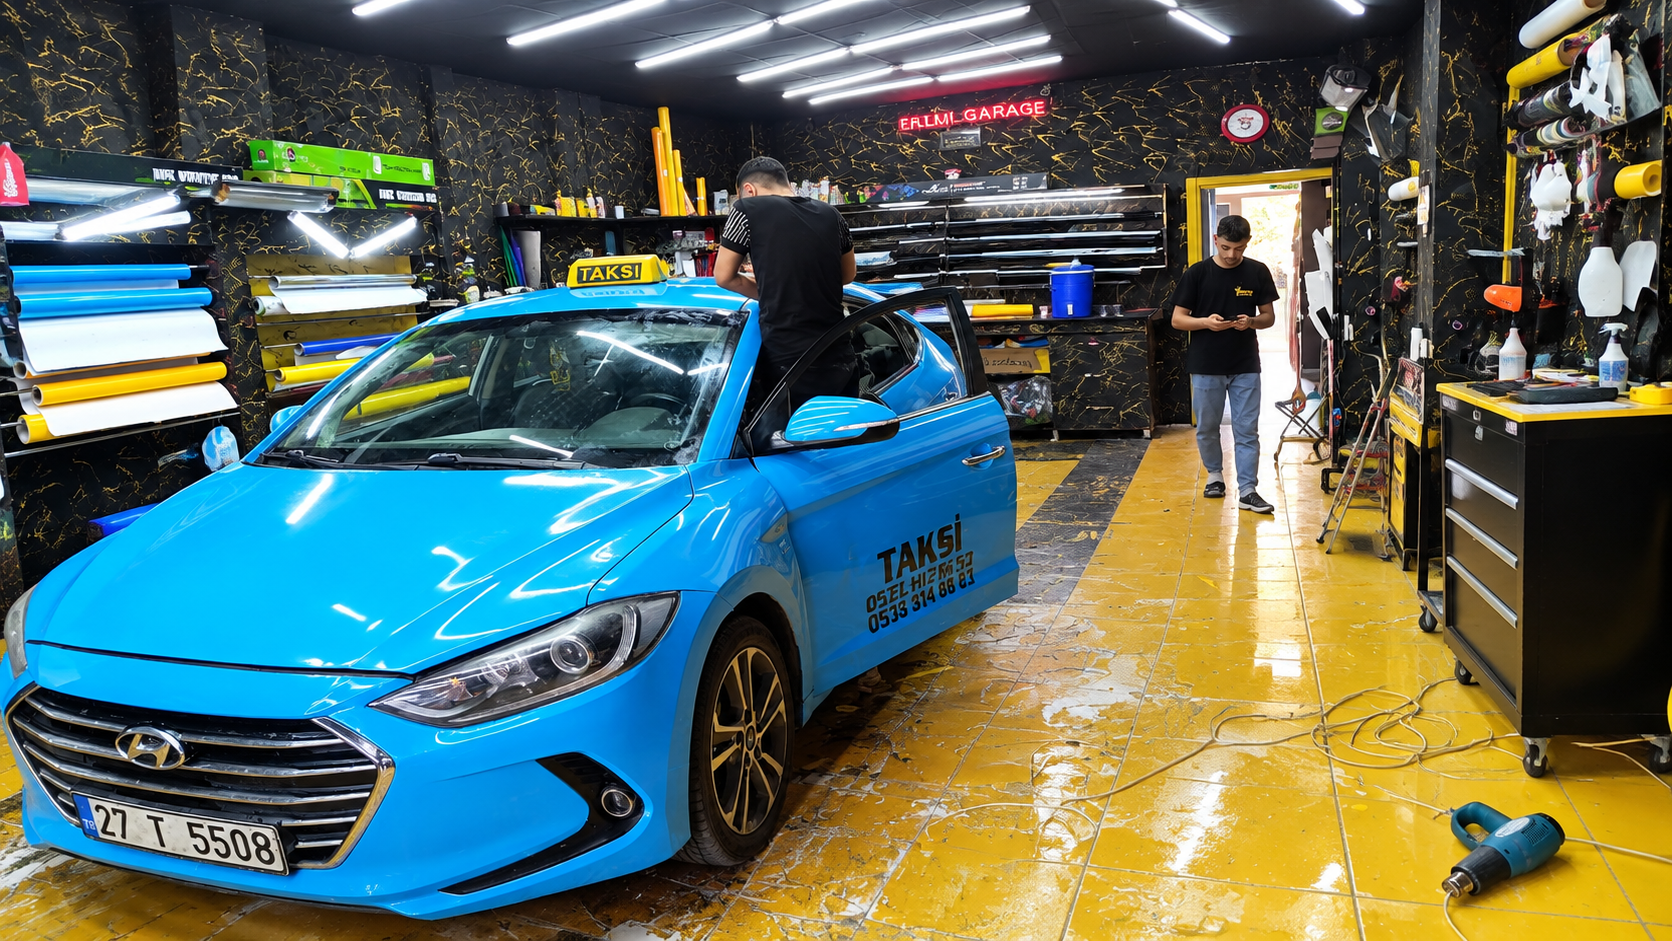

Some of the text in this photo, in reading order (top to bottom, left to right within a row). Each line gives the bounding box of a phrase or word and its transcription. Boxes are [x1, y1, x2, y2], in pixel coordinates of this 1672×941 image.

[964, 101, 1045, 121] GARAGE
[580, 265, 639, 282] TAKSI
[911, 586, 936, 612] 314
[95, 804, 127, 840] 27
[147, 815, 166, 848] T
[186, 822, 275, 866] 5508
